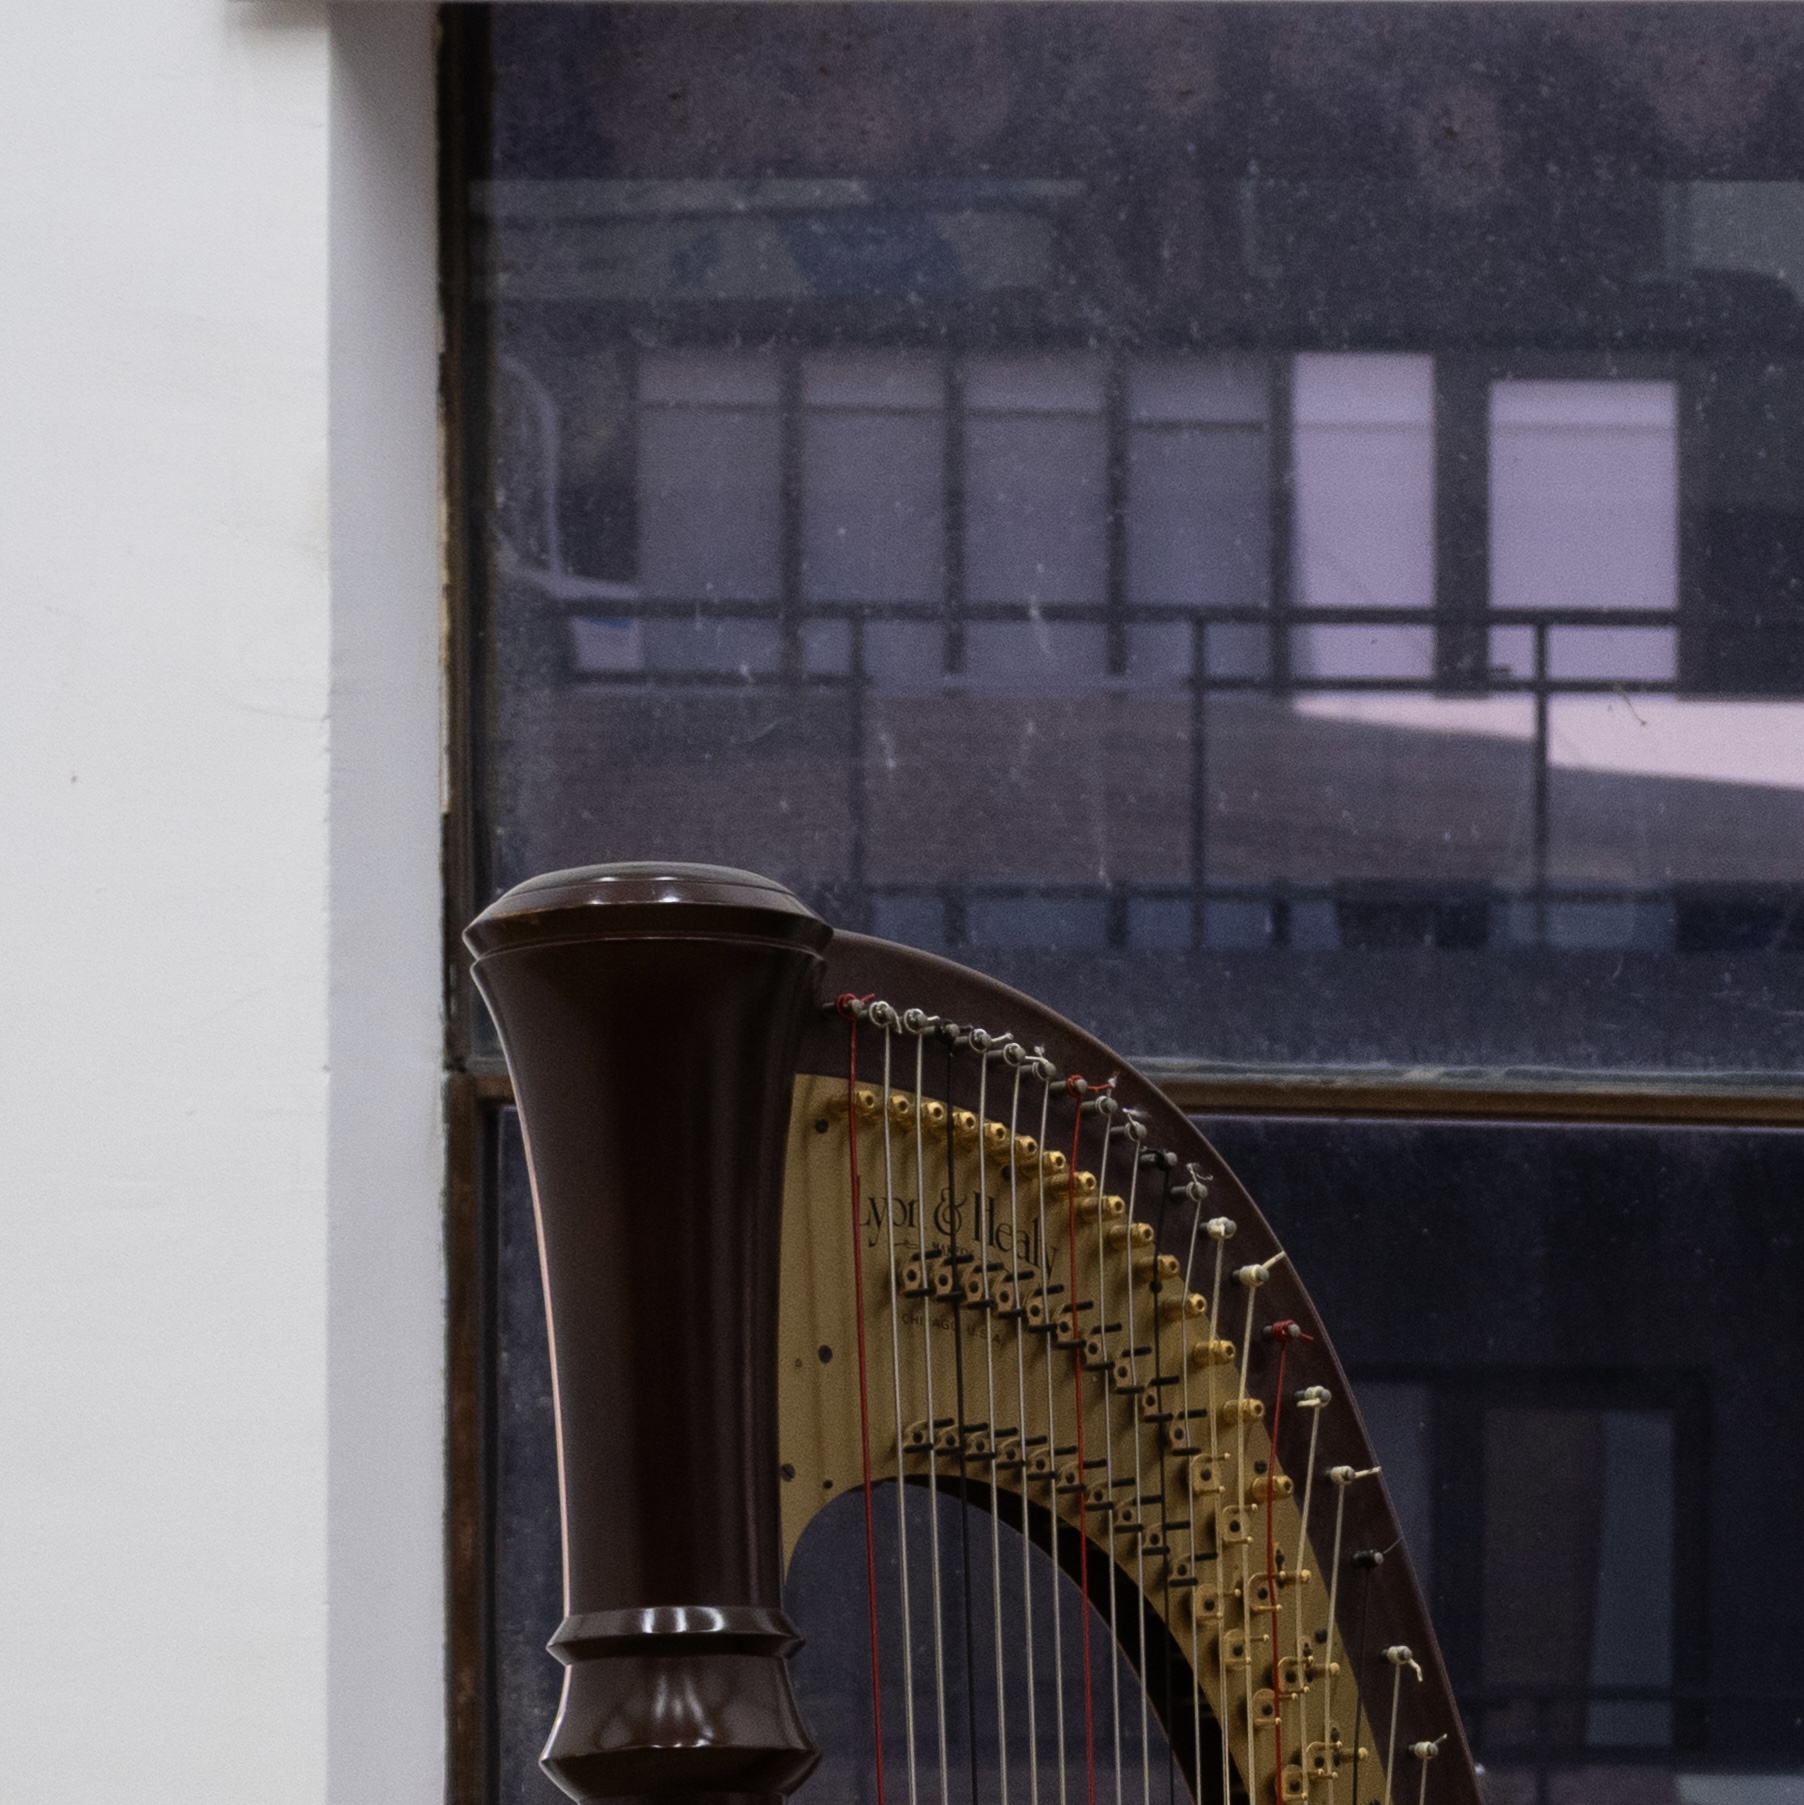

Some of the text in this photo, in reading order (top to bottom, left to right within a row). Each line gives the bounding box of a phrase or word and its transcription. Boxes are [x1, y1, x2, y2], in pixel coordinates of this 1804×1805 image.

[934, 1187, 968, 1236] &
[972, 1189, 1060, 1286] Healy
[901, 1312, 959, 1332] CHIAG
